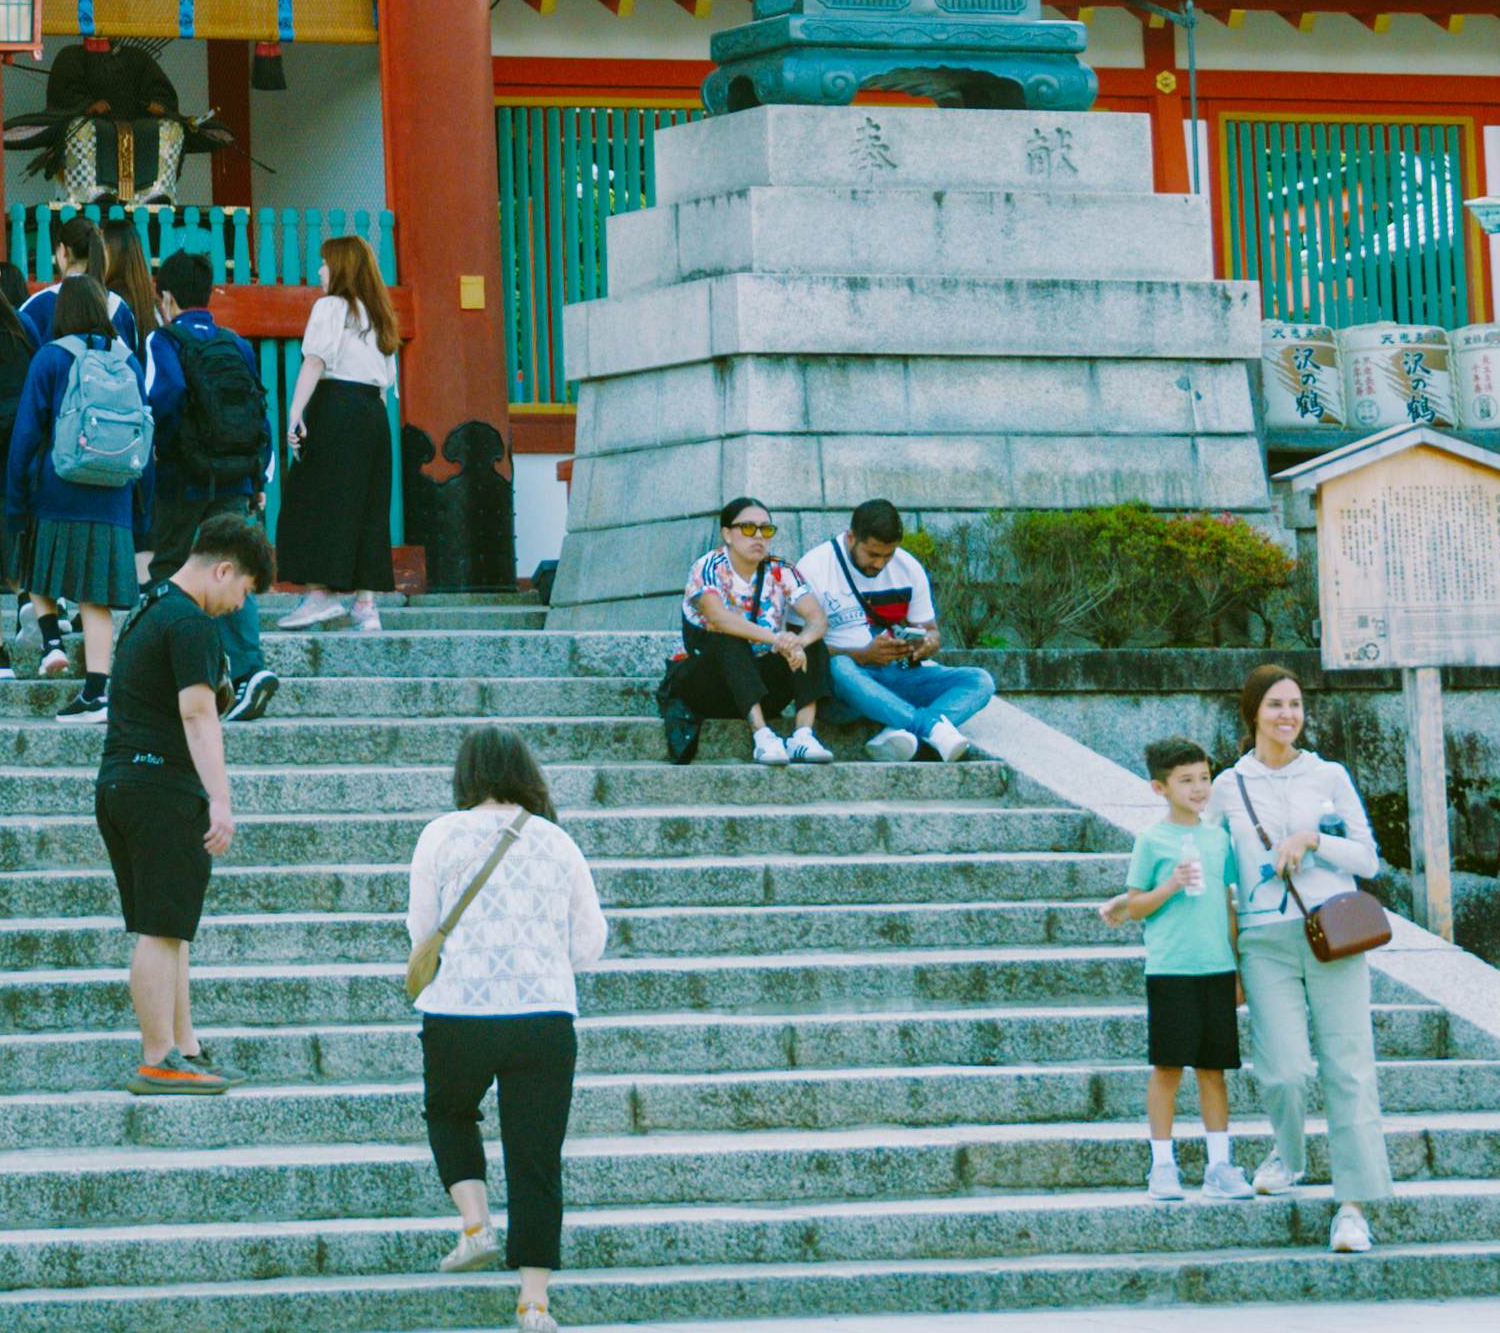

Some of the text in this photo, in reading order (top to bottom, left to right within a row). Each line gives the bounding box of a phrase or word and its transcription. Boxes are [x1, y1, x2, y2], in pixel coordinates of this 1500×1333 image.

[1293, 346, 1325, 420] 沢の鶴
[1401, 351, 1436, 423] 沢の鶴
